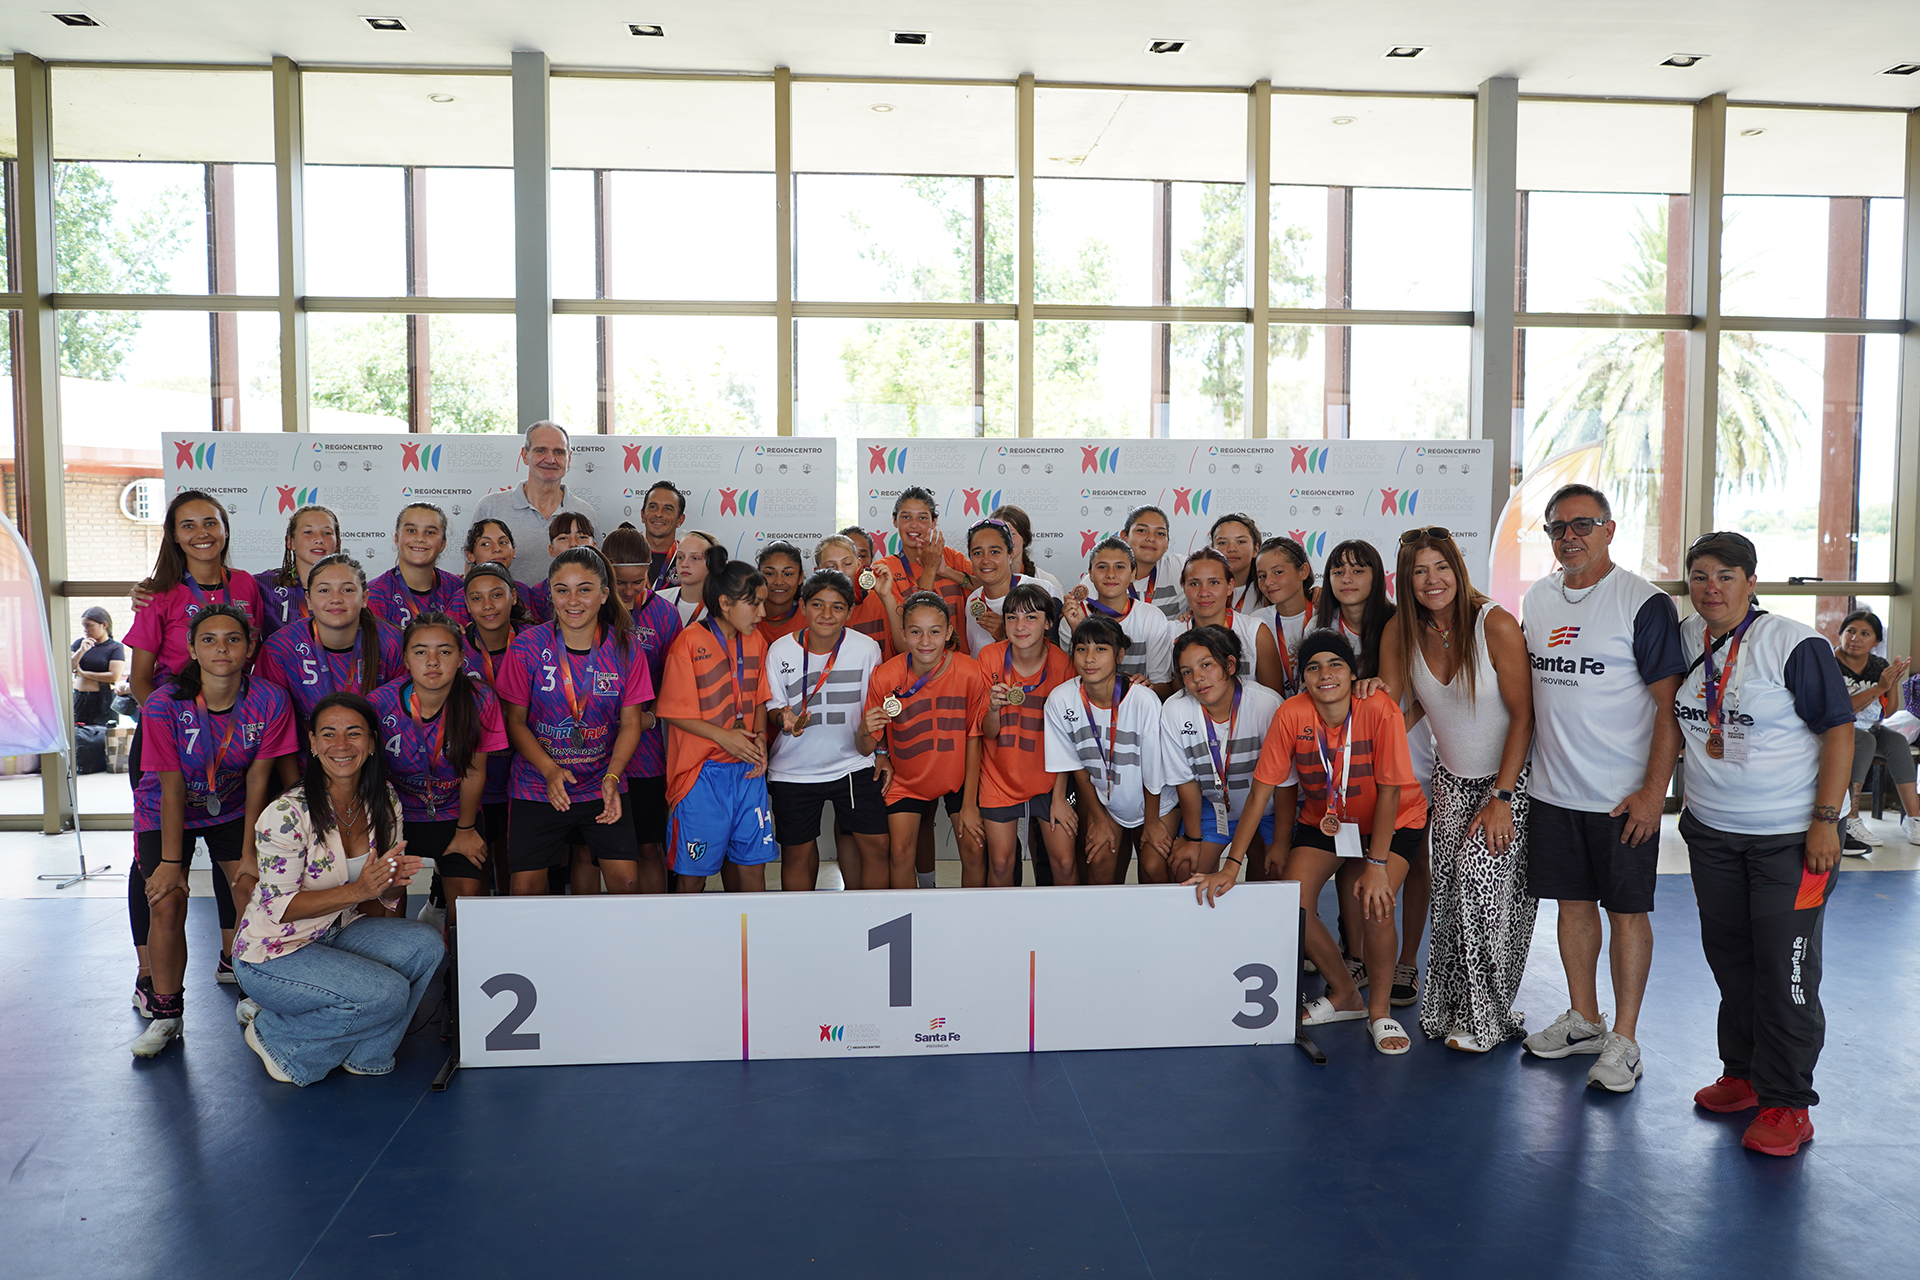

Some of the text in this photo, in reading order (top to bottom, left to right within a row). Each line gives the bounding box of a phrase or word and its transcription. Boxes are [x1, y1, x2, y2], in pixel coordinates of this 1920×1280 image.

[281, 600, 289, 622] 1
[303, 659, 318, 685] 5
[1529, 652, 1605, 675] Santa Fe
[541, 665, 557, 692] 3
[1540, 677, 1579, 687] PROVINCIA
[185, 728, 200, 754] 7
[385, 733, 402, 757] 4
[868, 913, 912, 1007] 1
[1791, 936, 1803, 983] Santa Fe
[1232, 963, 1279, 1030] 3
[480, 972, 540, 1050] 2
[914, 1032, 961, 1042] Santa Fe
